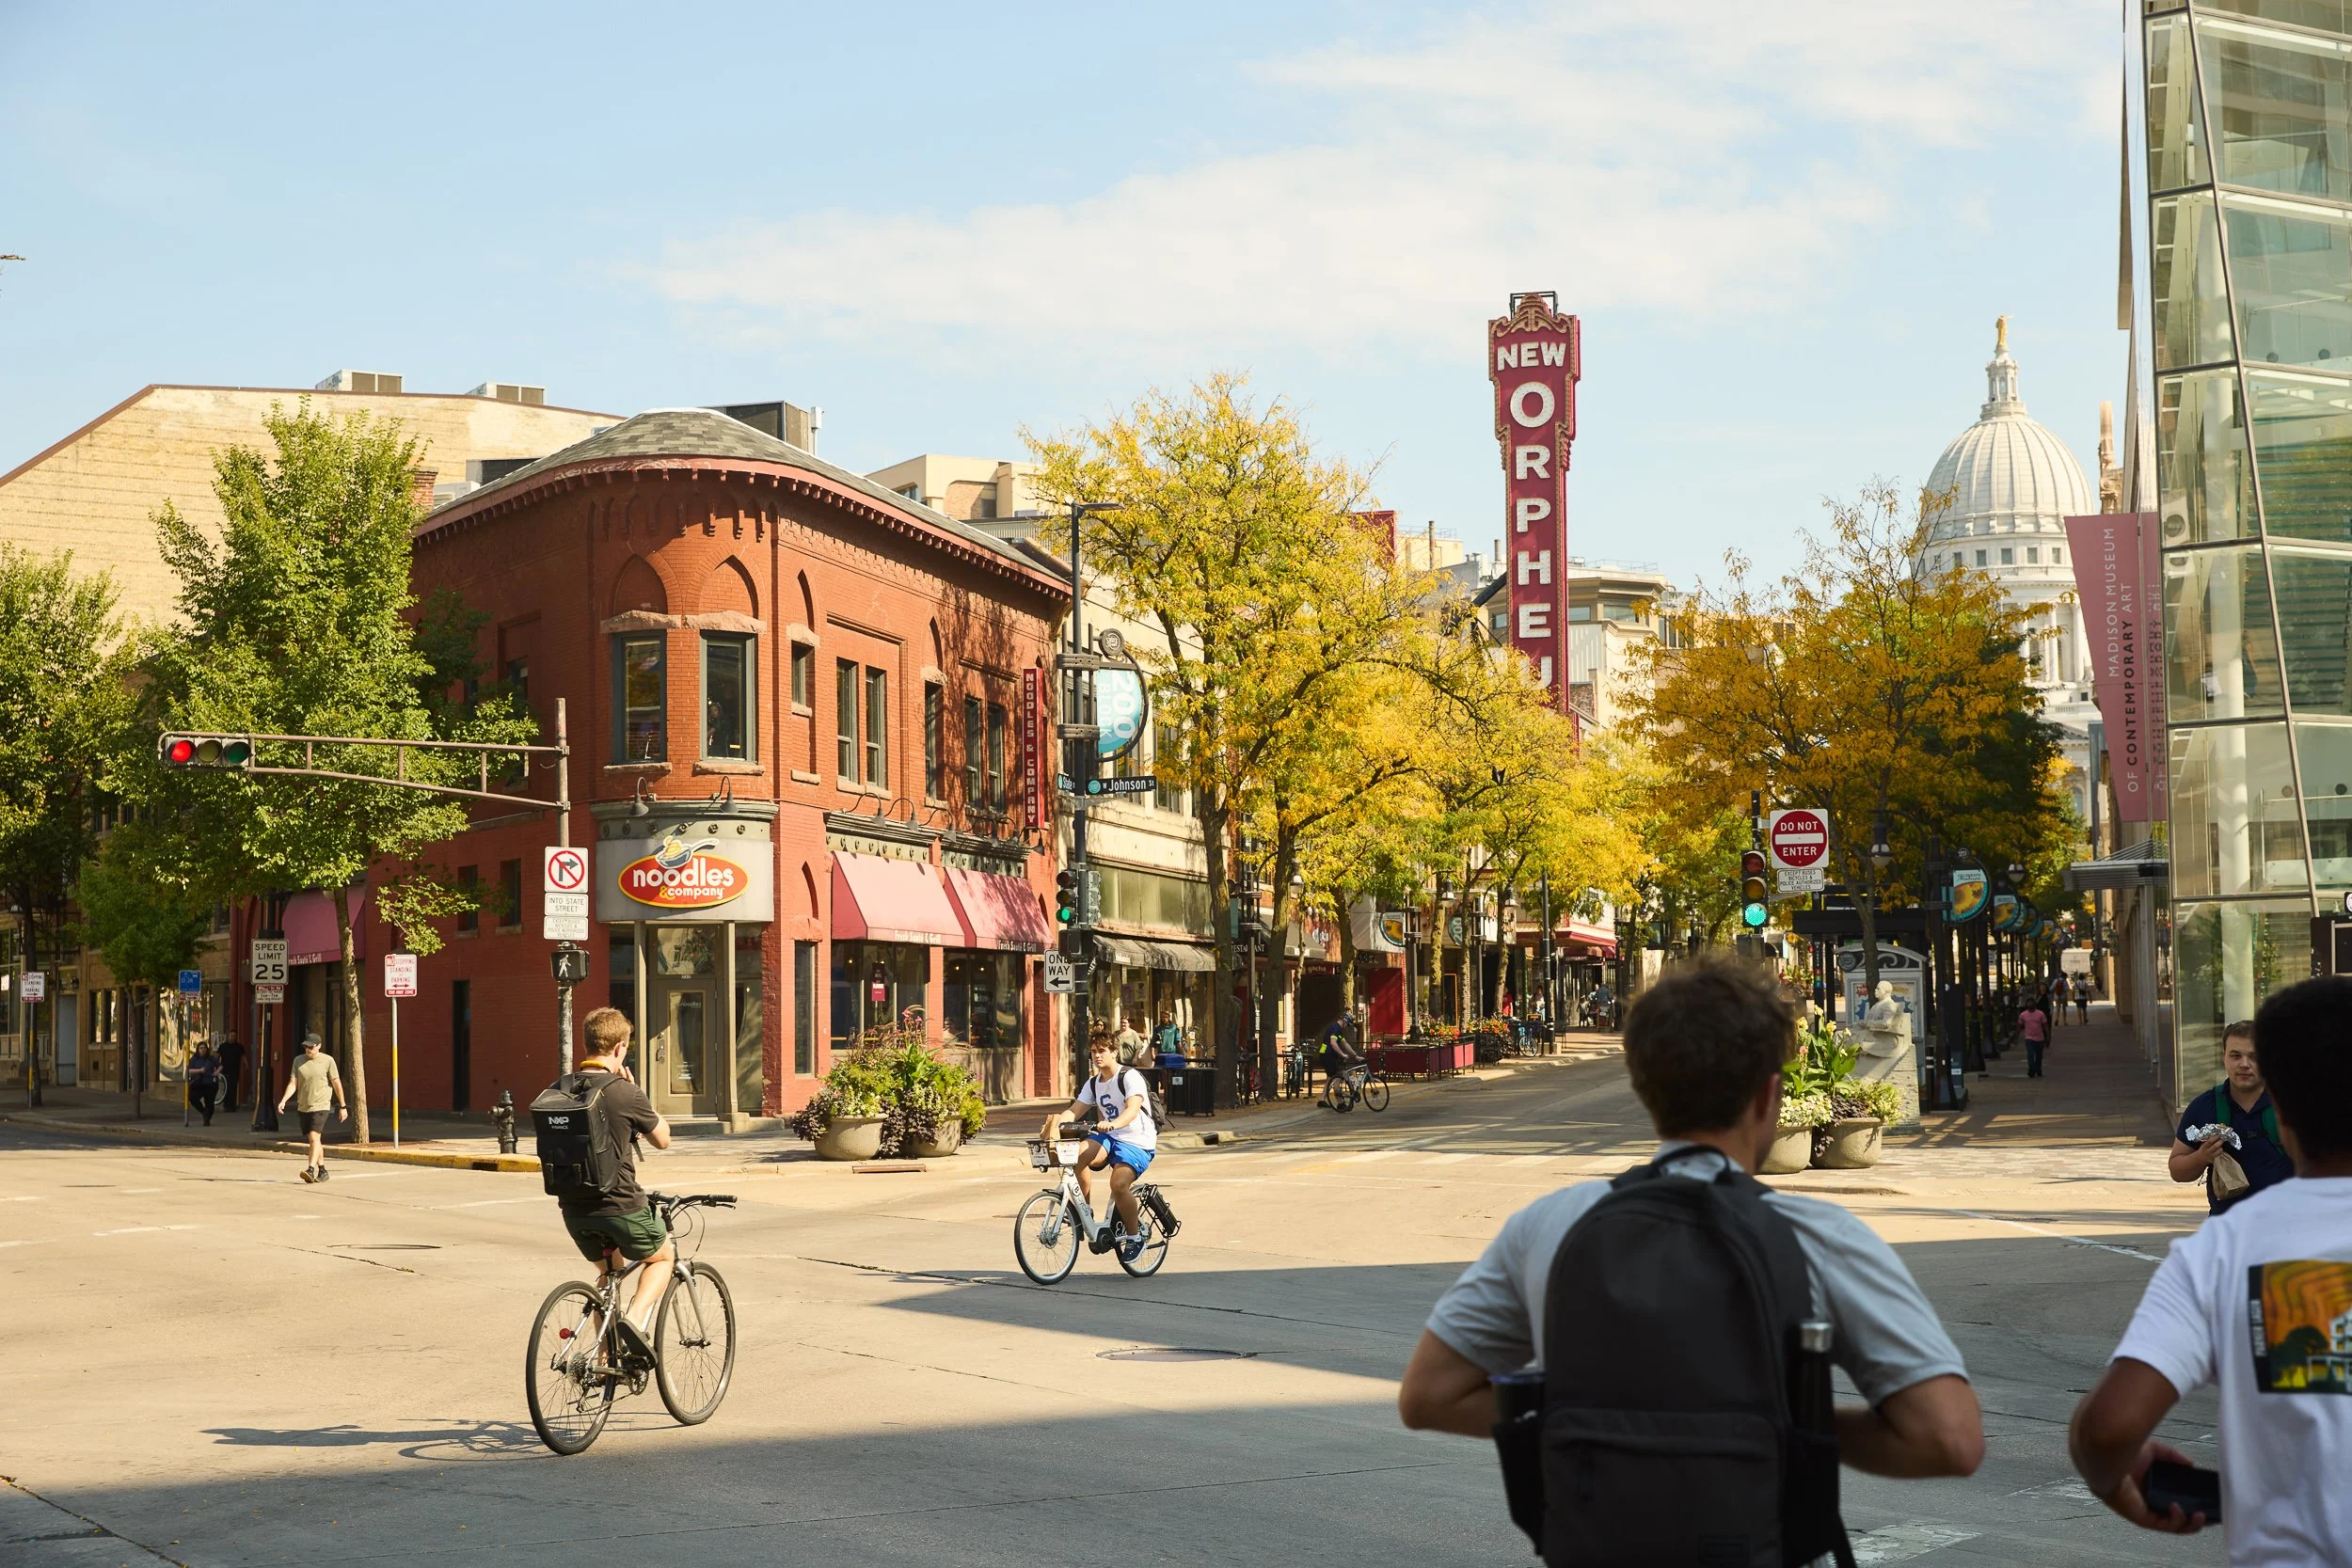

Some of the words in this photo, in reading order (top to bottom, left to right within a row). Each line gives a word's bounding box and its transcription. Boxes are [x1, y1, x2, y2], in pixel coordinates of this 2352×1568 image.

[1497, 341, 1567, 372] NEW
[2104, 528, 2116, 595] MUSEUM
[2121, 583, 2133, 613] ART
[2108, 600, 2120, 677] MADISON
[2122, 620, 2138, 767] CONTEMPORARY
[1025, 673, 1034, 737] NOODLES
[1099, 684, 1112, 739] BLOCK
[1112, 670, 1136, 739] 200
[1026, 744, 1034, 752] &
[1026, 759, 1035, 824] COMPANY
[1063, 776, 1073, 790] State
[1108, 779, 1146, 791] Johnson
[2127, 772, 2139, 793] OF
[1780, 822, 1794, 832] DO
[1797, 821, 1818, 831] NOT
[1783, 847, 1817, 856] ENTER
[633, 858, 735, 887] noodles
[895, 930, 909, 942] Fresh
[999, 940, 1009, 950] Fresh
[288, 956, 296, 965] resh
[1048, 966, 1070, 975] WAY
[255, 963, 284, 980] 25
